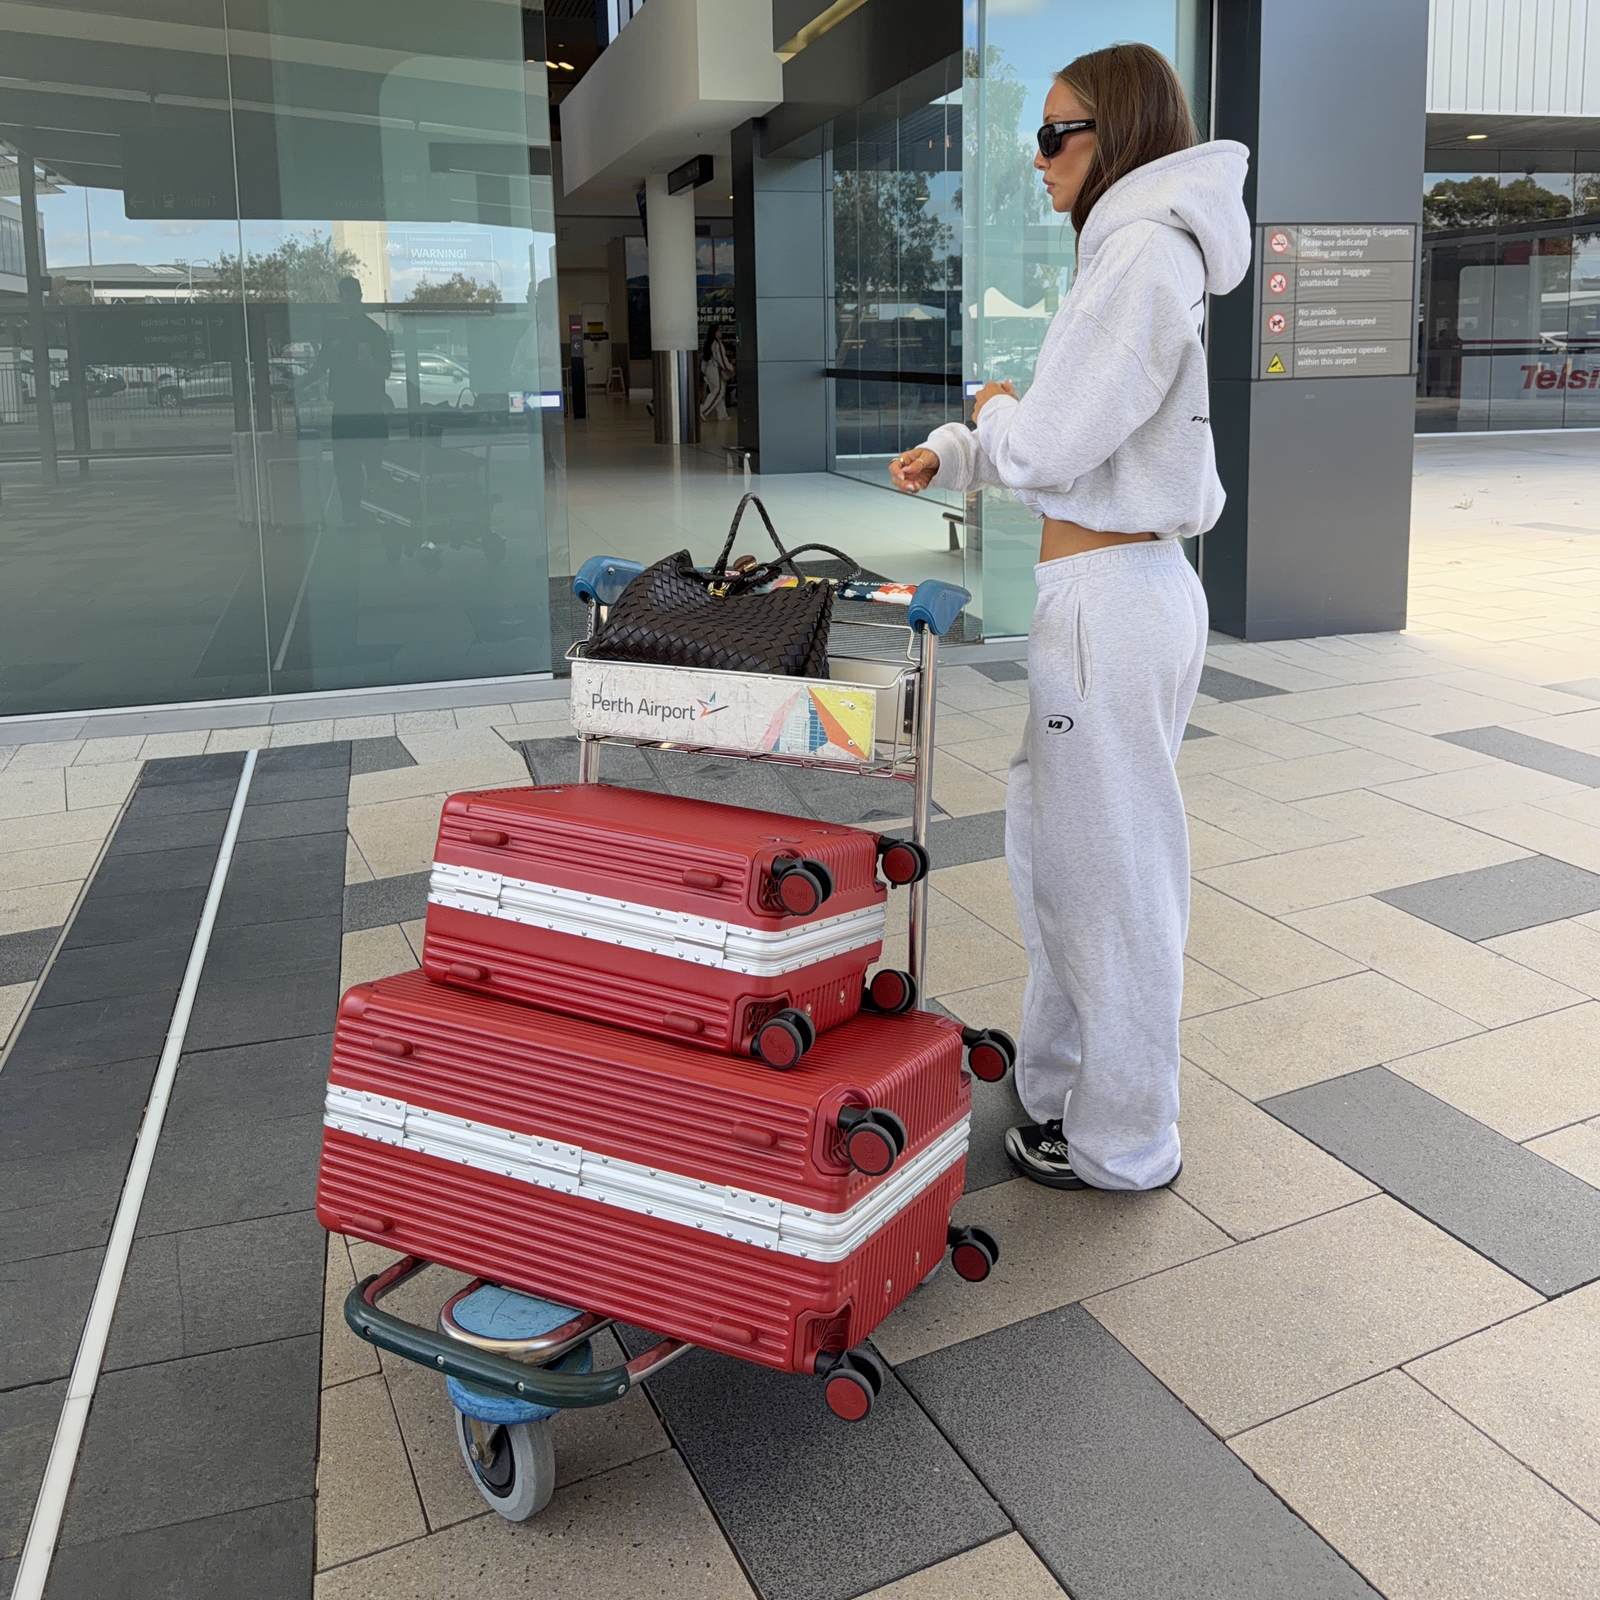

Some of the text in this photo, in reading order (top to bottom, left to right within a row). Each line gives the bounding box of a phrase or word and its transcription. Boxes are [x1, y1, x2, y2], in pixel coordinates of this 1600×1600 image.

[1312, 228, 1341, 238] Smoking
[1342, 228, 1372, 238] including
[1373, 228, 1410, 238] E-cigarettes
[410, 248, 466, 259] WARNING!
[1300, 250, 1329, 258] smoking
[1348, 249, 1363, 258] only
[1343, 268, 1370, 277] baggage
[1300, 278, 1338, 287] unattended
[1346, 318, 1376, 326] excepted
[1318, 346, 1357, 354] surveillance
[1358, 346, 1386, 355] operates
[1298, 358, 1320, 366] within
[1334, 357, 1357, 366] airport
[1520, 364, 1600, 390] Telsi
[592, 693, 696, 721] Perth Airport
